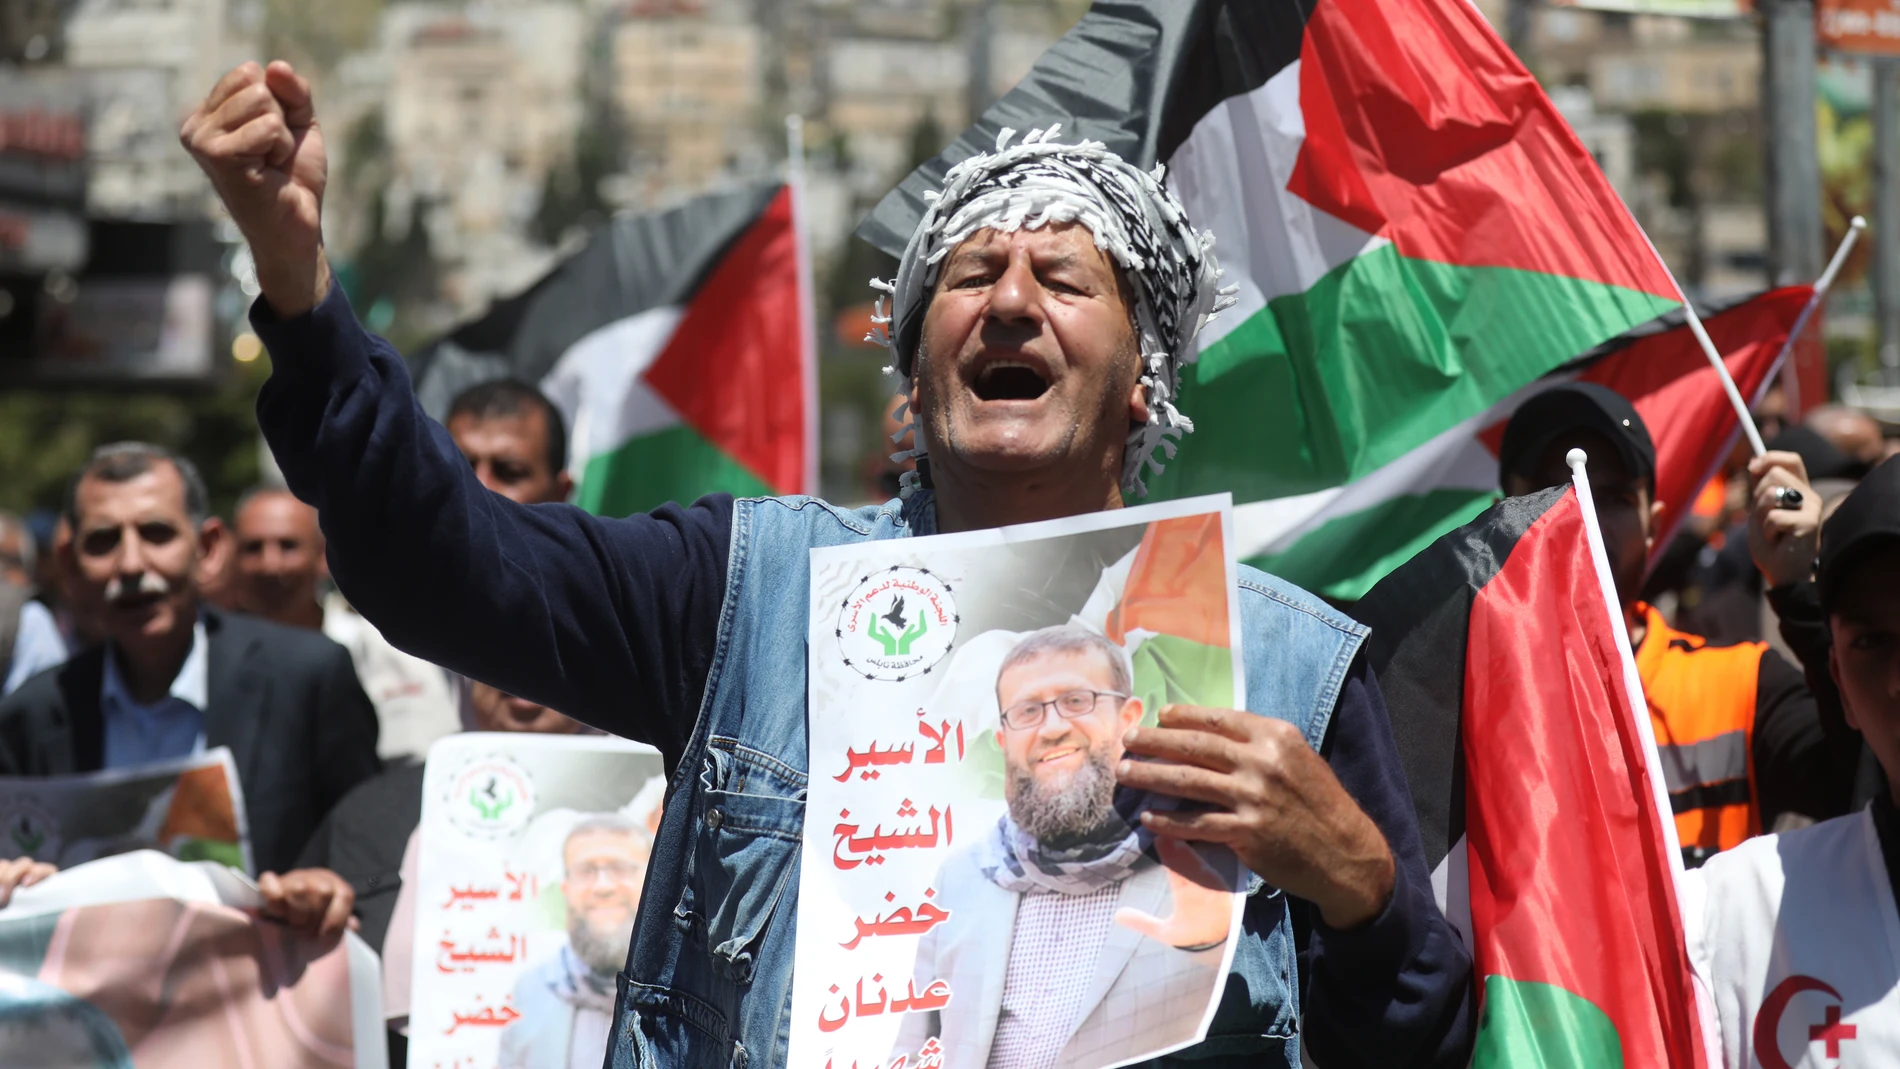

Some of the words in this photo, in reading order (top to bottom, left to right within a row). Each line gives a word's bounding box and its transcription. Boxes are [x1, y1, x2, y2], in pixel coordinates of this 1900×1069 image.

[865, 581, 890, 603] لدعم
[892, 578, 933, 597] الوطنية
[930, 593, 948, 626] اللجنة
[832, 707, 965, 783] الأسير
[832, 798, 953, 870] الشيخ
[838, 888, 951, 951] خضر
[436, 925, 528, 975] الشيخ
[443, 995, 521, 1036] خضر
[817, 972, 951, 1033] عدنان
